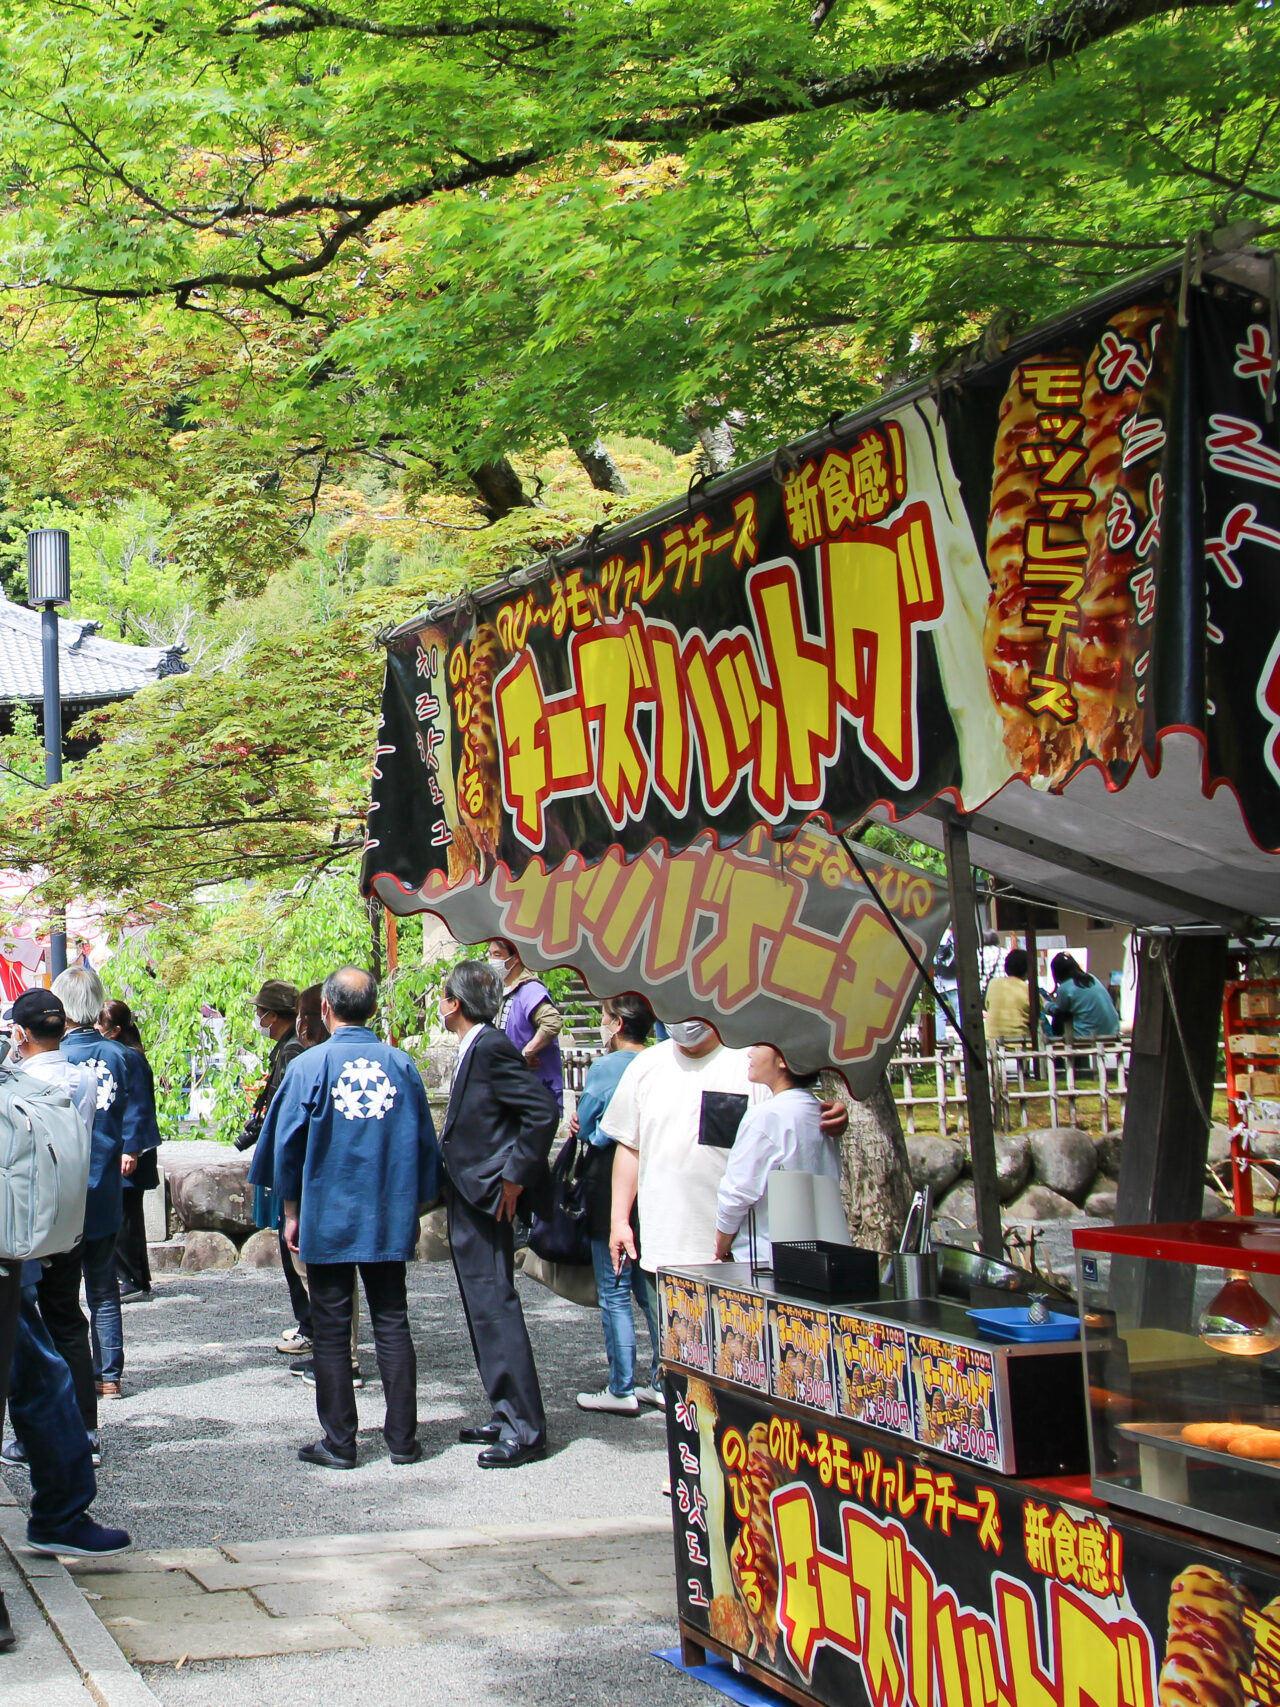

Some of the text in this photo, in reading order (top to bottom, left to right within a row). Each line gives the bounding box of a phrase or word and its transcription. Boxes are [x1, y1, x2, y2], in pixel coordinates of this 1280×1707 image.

[785, 422, 907, 549] 新食感!
[1018, 363, 1096, 726] モッツァレラチーズ
[494, 497, 945, 851] チーズハットグ
[416, 646, 454, 847] 치즈핫도그
[719, 1299, 766, 1341] チーズハットグ
[777, 1314, 831, 1361] チーズハットグ
[842, 1333, 907, 1383] チーズハットグ
[921, 1354, 994, 1410] チーズハットグ
[675, 1391, 710, 1608] 치즈핫도그
[1023, 1498, 1124, 1600] 新食感!
